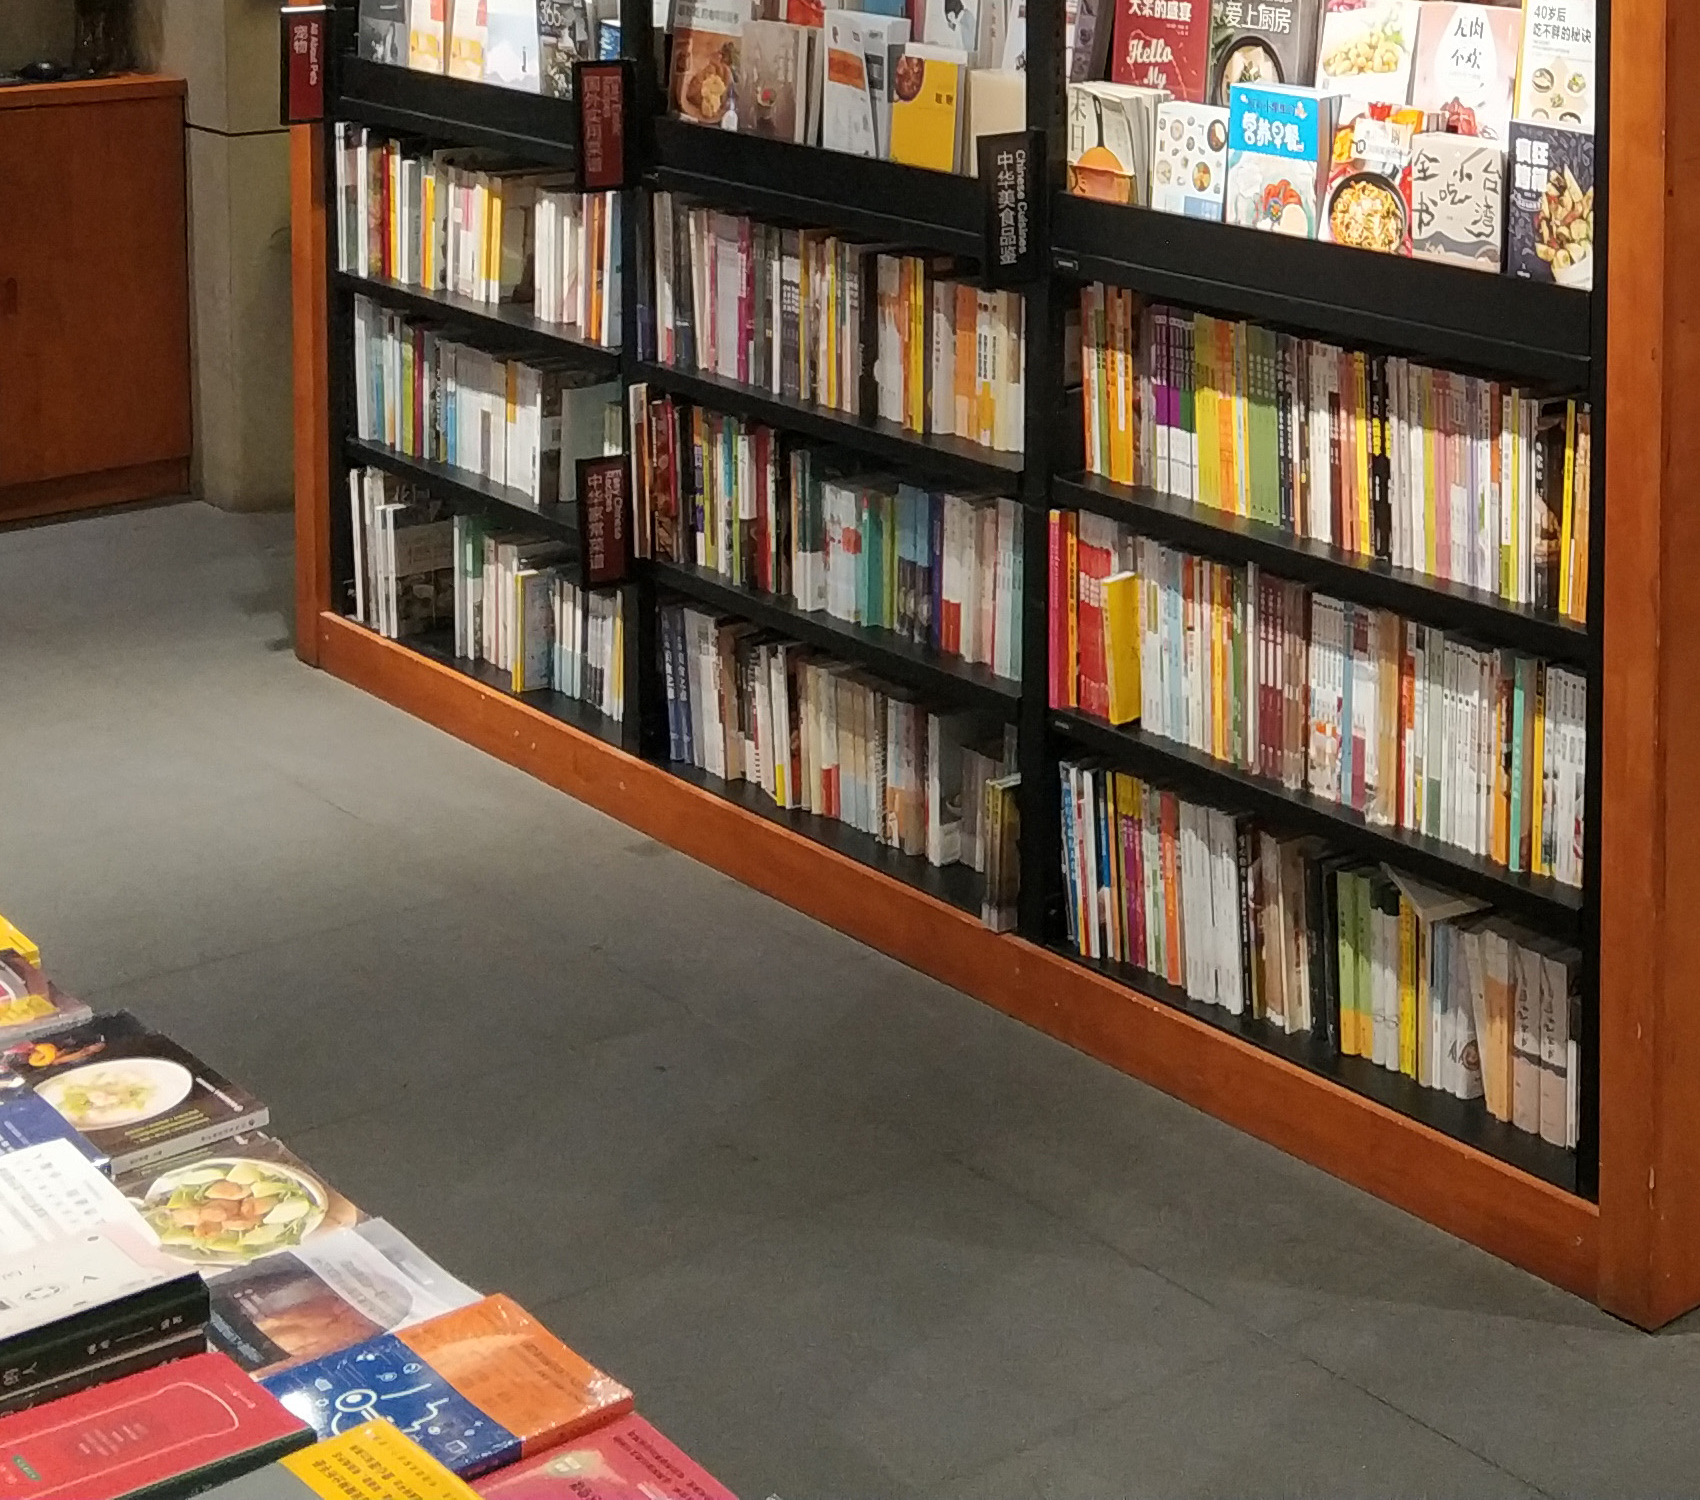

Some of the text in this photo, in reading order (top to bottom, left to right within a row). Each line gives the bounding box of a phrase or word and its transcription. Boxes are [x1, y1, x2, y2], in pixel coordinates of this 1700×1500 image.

[1225, 0, 1292, 34] 爱上厨房
[1534, 5, 1567, 23] 40岁后
[1126, 38, 1174, 64] Hello
[1142, 65, 1168, 89] My
[1242, 111, 1305, 153] 营养早餐
[1015, 149, 1027, 200] Chinese
[997, 150, 1018, 266] 中华美食品鉴
